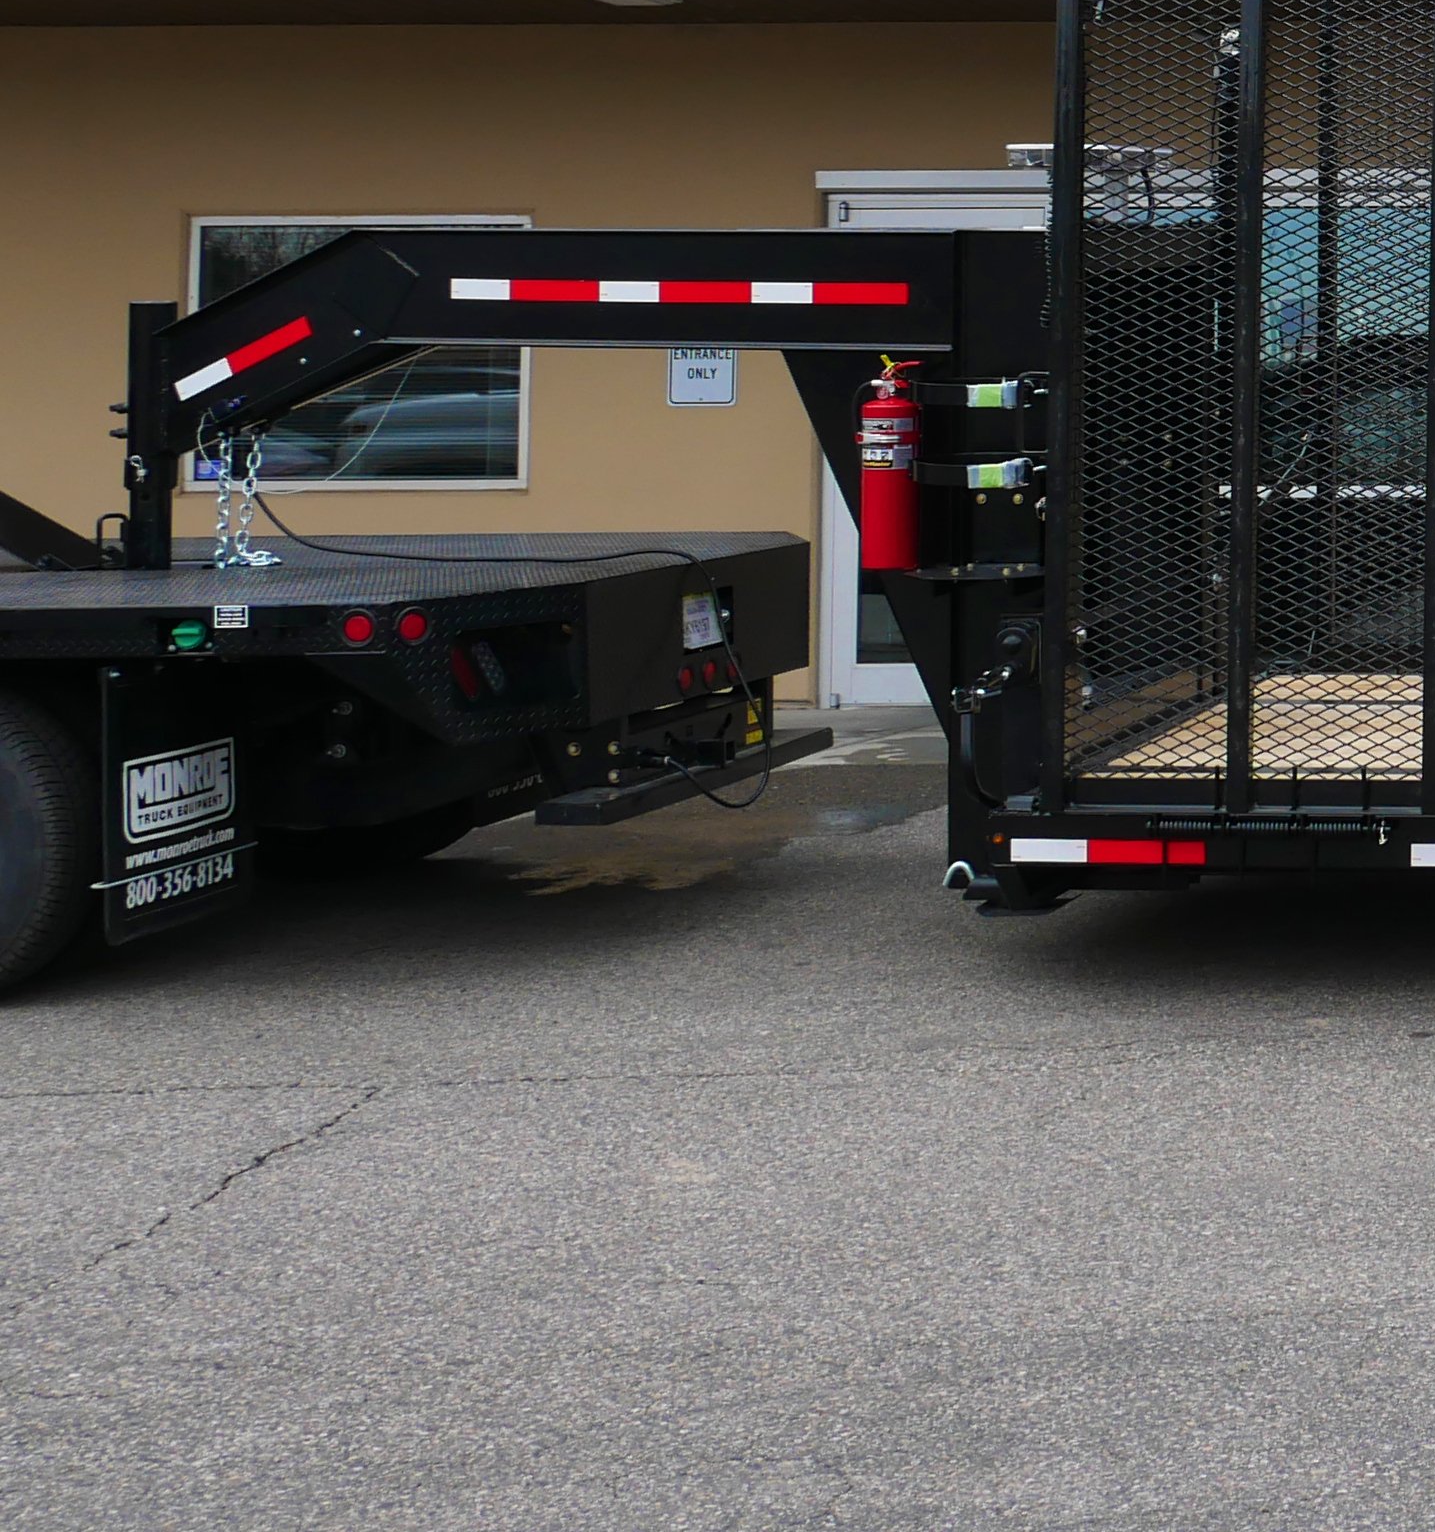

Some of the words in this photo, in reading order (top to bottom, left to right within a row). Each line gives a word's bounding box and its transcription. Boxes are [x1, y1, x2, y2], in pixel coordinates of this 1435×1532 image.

[673, 348, 732, 360] ENTRANCE
[687, 368, 717, 379] ONLY
[129, 747, 230, 807] MONROE
[138, 807, 173, 825] TRUCK
[177, 794, 223, 816] EQUIPMENT
[126, 853, 234, 909] 800-356-8134
